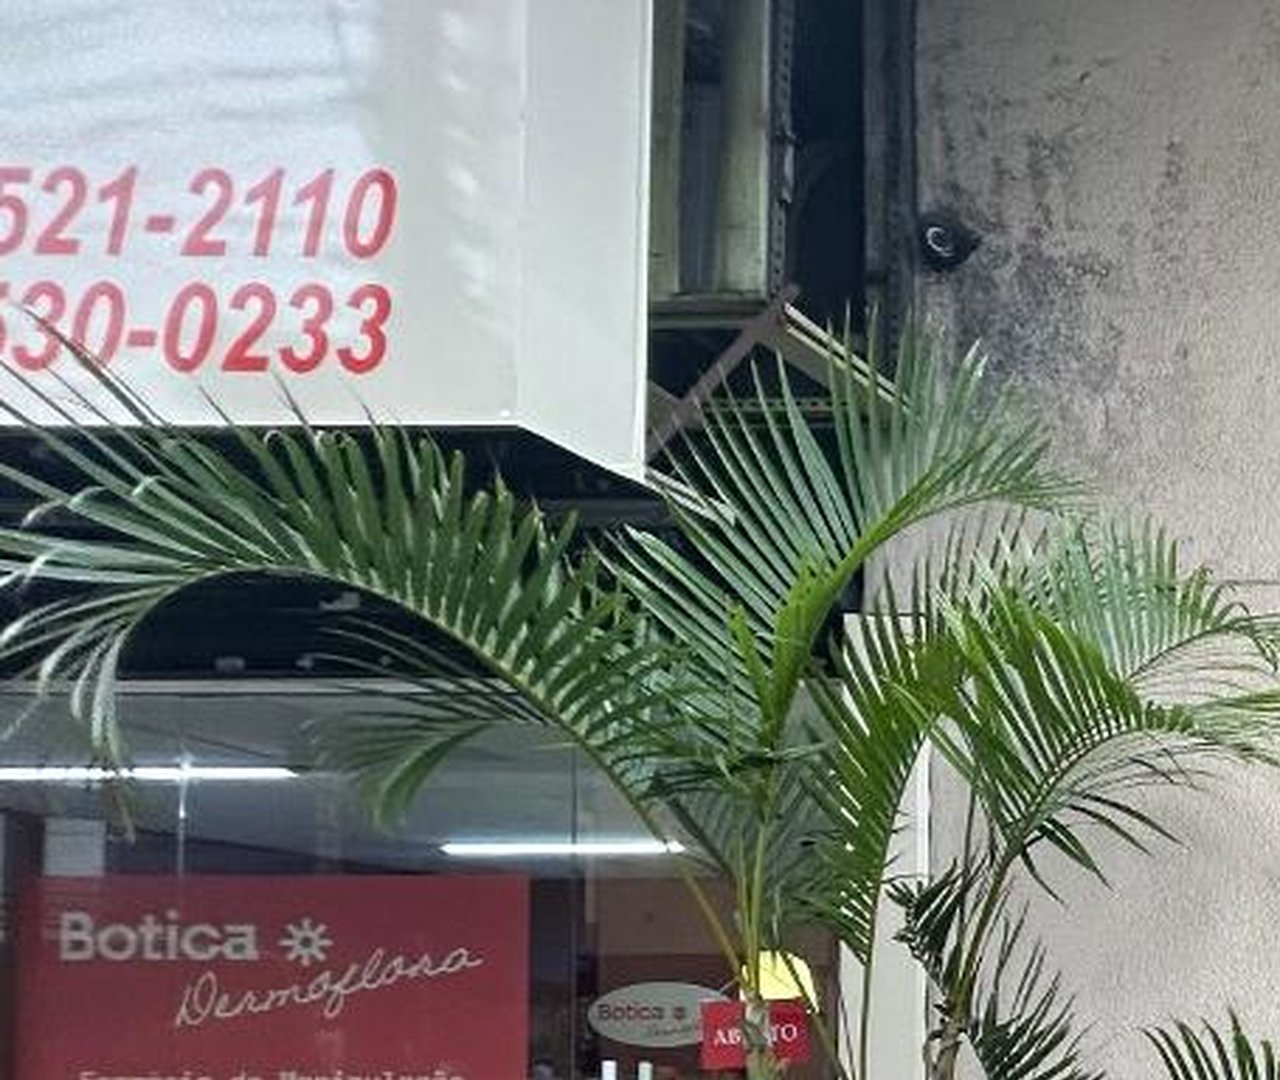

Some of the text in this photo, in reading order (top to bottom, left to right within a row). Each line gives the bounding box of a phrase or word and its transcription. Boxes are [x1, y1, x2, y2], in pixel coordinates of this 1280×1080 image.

[0, 281, 393, 374] 30-0233
[59, 910, 259, 962] Botica
[175, 946, 483, 1027] Dermoflora
[714, 1024, 798, 1046] ABTO
